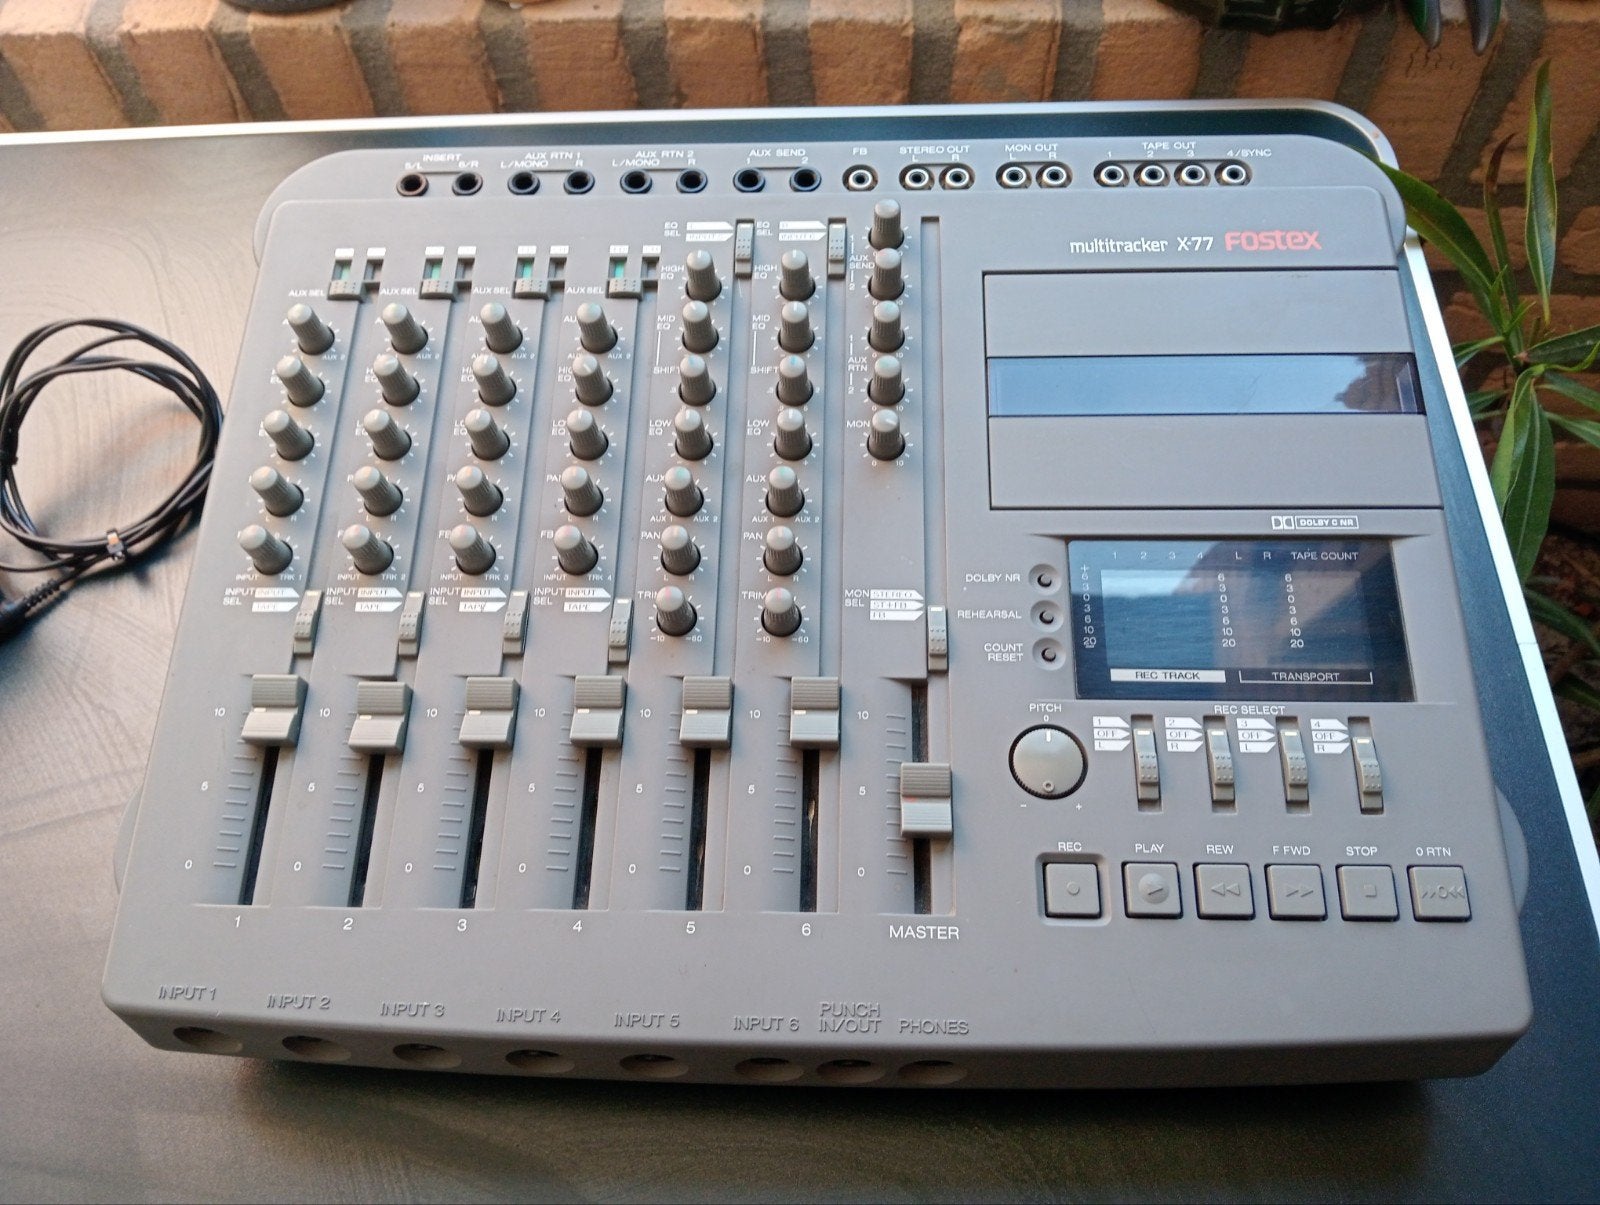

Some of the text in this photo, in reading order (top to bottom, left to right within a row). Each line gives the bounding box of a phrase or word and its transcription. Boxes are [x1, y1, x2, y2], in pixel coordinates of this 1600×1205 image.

[900, 146, 944, 154] STEREO
[1005, 144, 1058, 152] MON OUT
[1142, 142, 1170, 150] TAPE
[776, 148, 806, 156] SEND
[423, 154, 461, 162] INSERT
[757, 221, 770, 229] EQ
[1070, 238, 1168, 253] multitracker
[661, 265, 684, 273] HIGH
[661, 272, 674, 280] EQ
[754, 272, 767, 280] EQ
[288, 289, 325, 297] AUX SEL
[380, 287, 418, 295] AUX SEL
[657, 322, 671, 330] EQ
[752, 322, 766, 330] EQ
[650, 420, 671, 428] LOW
[747, 420, 769, 428] LOW
[846, 420, 870, 428] MON
[649, 428, 663, 436] EQ
[747, 428, 761, 436] EQ
[746, 475, 766, 483] AUX
[641, 532, 660, 540] PAN
[743, 532, 762, 540] PAN
[1236, 552, 1242, 560] L
[1263, 552, 1271, 560] R
[1291, 552, 1358, 561] TAPE COUNT
[966, 574, 1002, 582] DOLBY
[225, 588, 255, 596] INPUT
[430, 587, 460, 595] INPUT
[534, 587, 565, 595] INPUT
[845, 590, 869, 598] MON
[223, 597, 242, 605] SEL
[324, 597, 344, 605] SEL
[429, 597, 448, 605] SEL
[533, 597, 553, 605] SEL
[845, 599, 864, 607] SEL
[957, 611, 1022, 619] REHEARSAL
[1222, 627, 1233, 636] 10
[1290, 628, 1301, 636] 10
[1222, 639, 1236, 647] 20
[1290, 639, 1304, 648] 20
[984, 643, 1023, 652] COUNT
[988, 653, 1023, 661] RESET
[1136, 671, 1200, 679] REC TRACK
[1272, 672, 1339, 681] TRANSPORT
[1029, 703, 1062, 713] PITCH
[1215, 706, 1285, 715] REC SELECT
[214, 708, 225, 717] 10
[319, 708, 330, 717] 10
[426, 708, 438, 718] 10
[534, 708, 545, 717] 10
[640, 709, 651, 718] 10
[749, 709, 760, 719] 10
[857, 710, 869, 720] 10
[1058, 843, 1082, 852] REC
[1135, 843, 1165, 853] PLAY
[1207, 845, 1233, 854] REW
[1273, 846, 1311, 856] F FWD
[1346, 846, 1377, 856] STOP
[1427, 847, 1451, 857] RTN
[235, 917, 241, 928] 1
[343, 918, 353, 930] 2
[457, 919, 467, 931] 3
[573, 920, 582, 932] 4
[686, 922, 695, 934] 5
[802, 924, 811, 936] 6
[889, 926, 959, 939] MASTER
[159, 986, 216, 1000] INPUT 1
[267, 994, 330, 1010] INPUT 2
[380, 1002, 444, 1017] INPUT 3
[820, 1002, 880, 1017] PUNCH
[497, 1008, 561, 1023] INPUT 4
[615, 1013, 680, 1028] INPUT 5
[734, 1017, 799, 1032] INPUT 6
[819, 1018, 882, 1032] IN/OUT
[899, 1019, 969, 1034] PHONES
